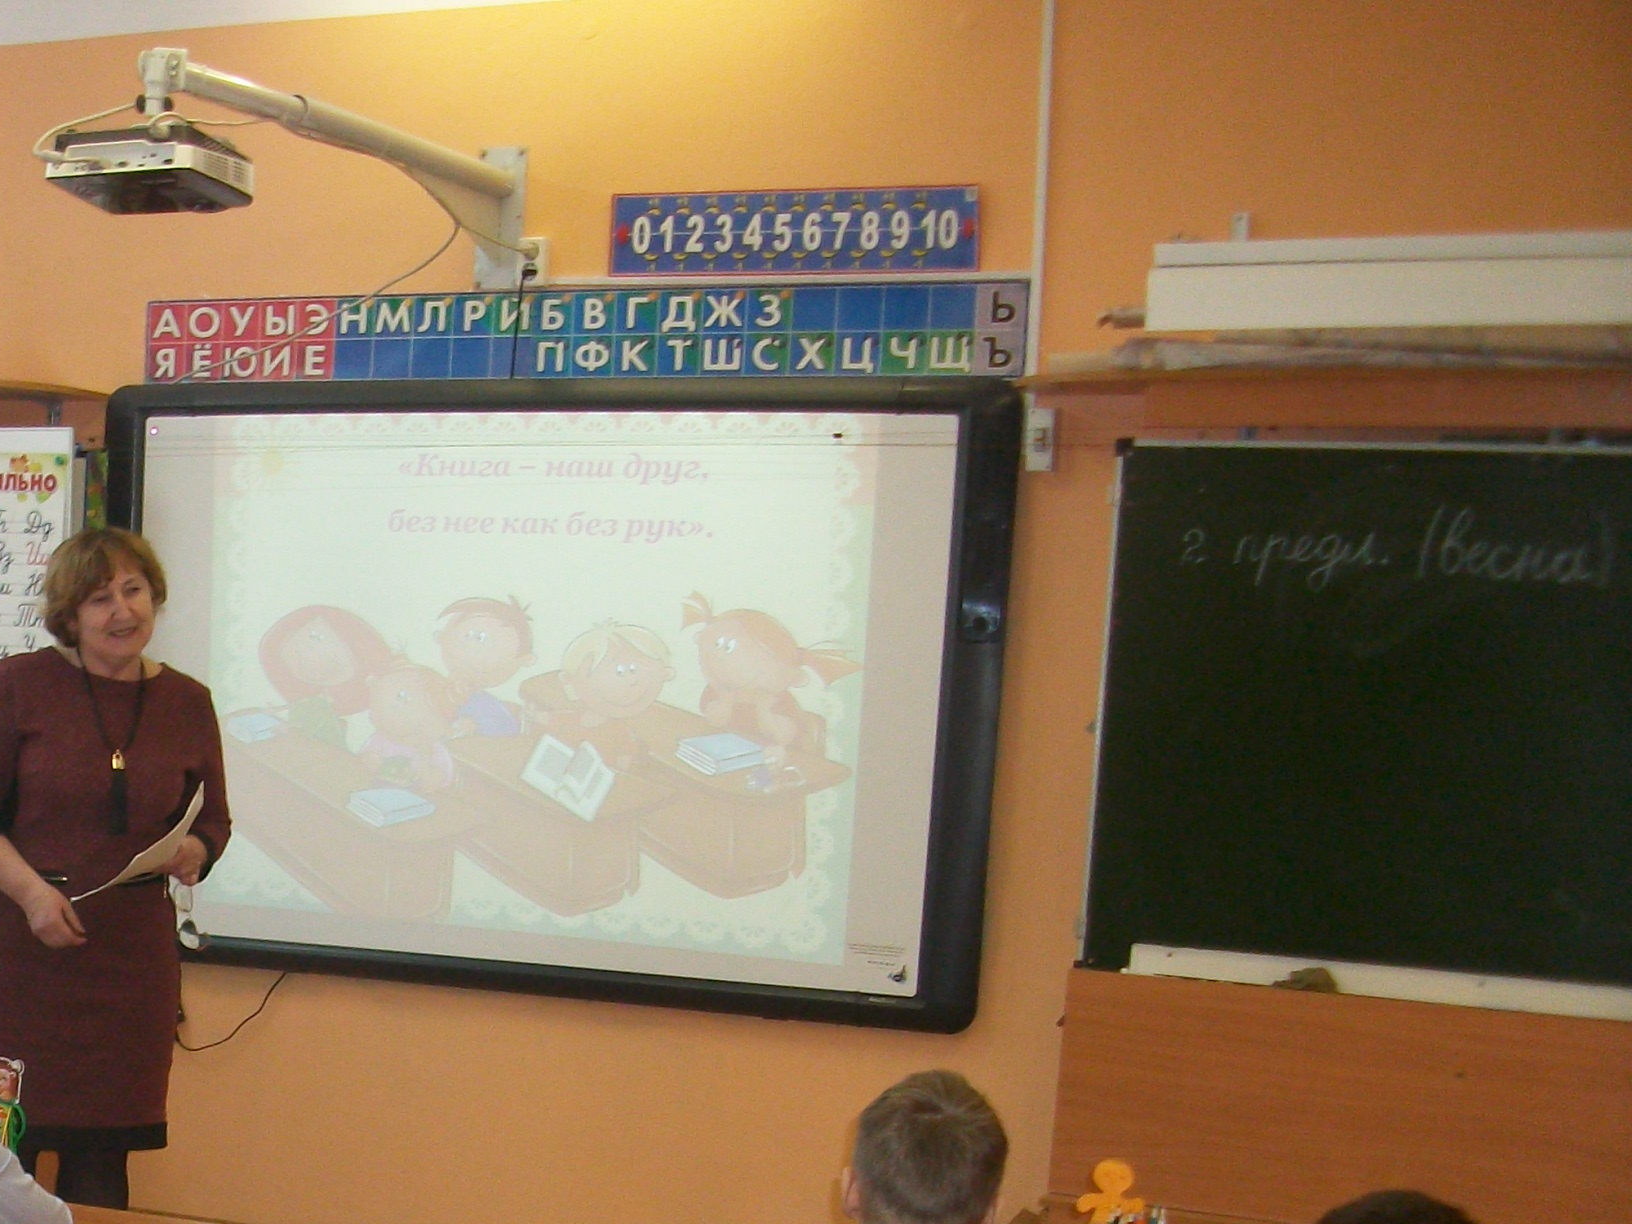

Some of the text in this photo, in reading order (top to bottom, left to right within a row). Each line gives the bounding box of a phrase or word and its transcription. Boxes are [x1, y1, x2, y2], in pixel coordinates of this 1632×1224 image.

[397, 452, 512, 478] «Книга
[544, 458, 614, 478] наш
[622, 452, 710, 485] друг,
[23, 510, 55, 542] Дд
[388, 508, 714, 544] без нее как без рук».
[1179, 527, 1206, 566] 2
